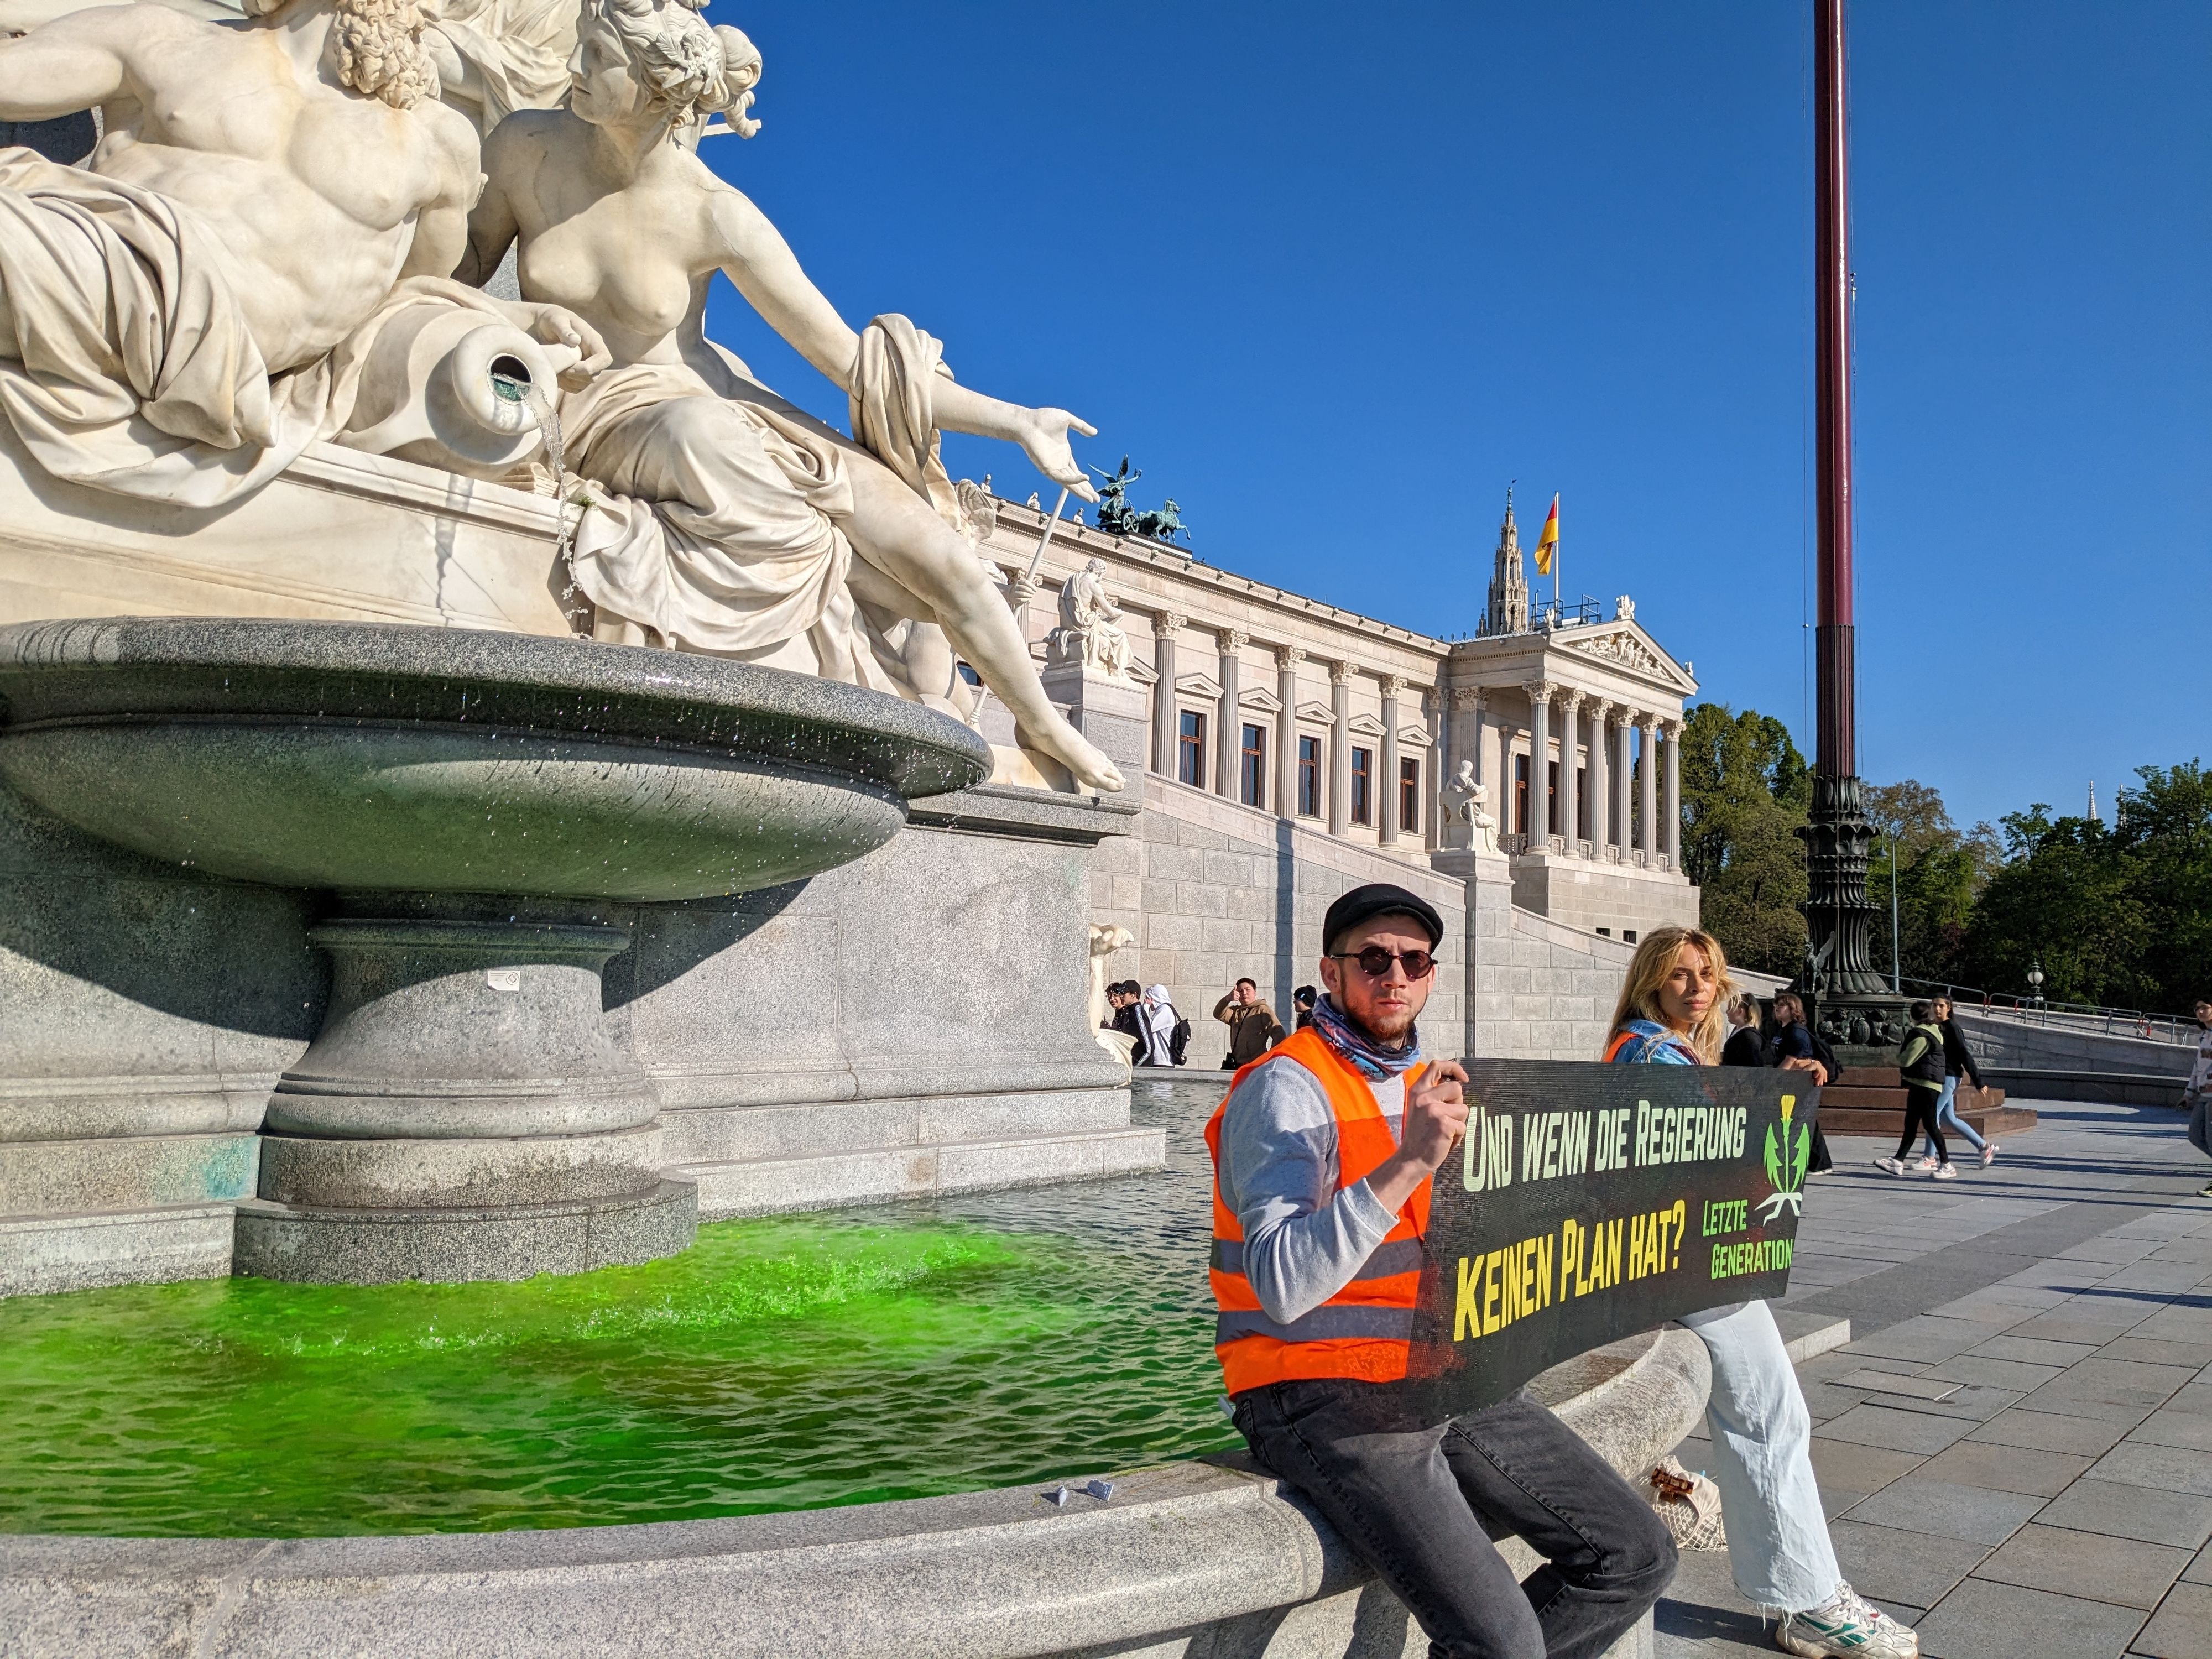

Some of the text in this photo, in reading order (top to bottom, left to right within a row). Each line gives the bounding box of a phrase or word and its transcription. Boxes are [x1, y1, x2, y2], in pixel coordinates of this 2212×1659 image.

[1463, 1100, 1747, 1192] UND WENN DIE REGIERUNG
[1703, 1199, 1748, 1237] LETZTE
[1454, 1199, 1686, 1342] KEINEN PLAN HAT?
[1711, 1238, 1793, 1280] GENERATION
